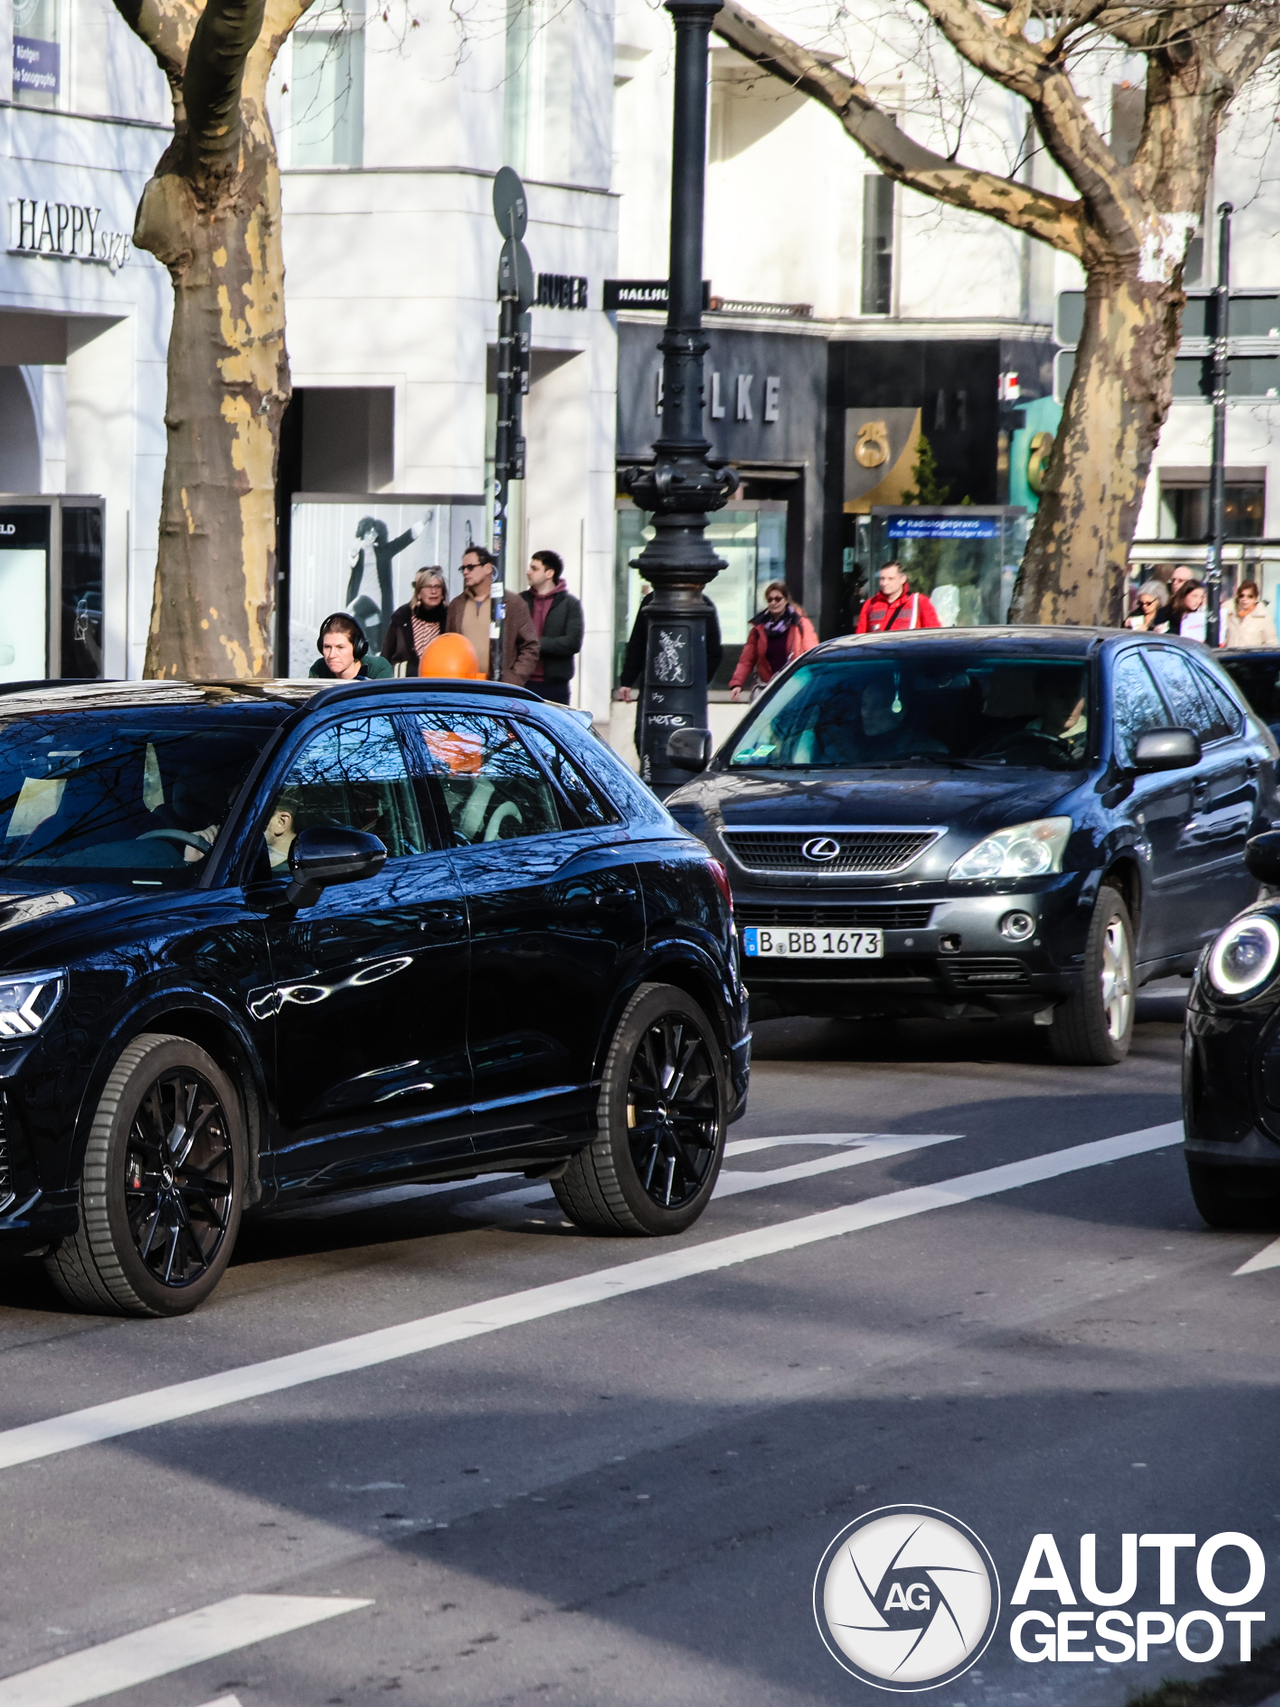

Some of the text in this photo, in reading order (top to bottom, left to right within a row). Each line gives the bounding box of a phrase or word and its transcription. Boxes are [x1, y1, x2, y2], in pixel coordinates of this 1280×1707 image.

[13, 198, 101, 257] HAPPY
[532, 273, 588, 309] HUBER
[657, 368, 780, 421] LKE
[760, 932, 773, 952] B
[788, 933, 816, 953] BB
[823, 933, 878, 953] 1673
